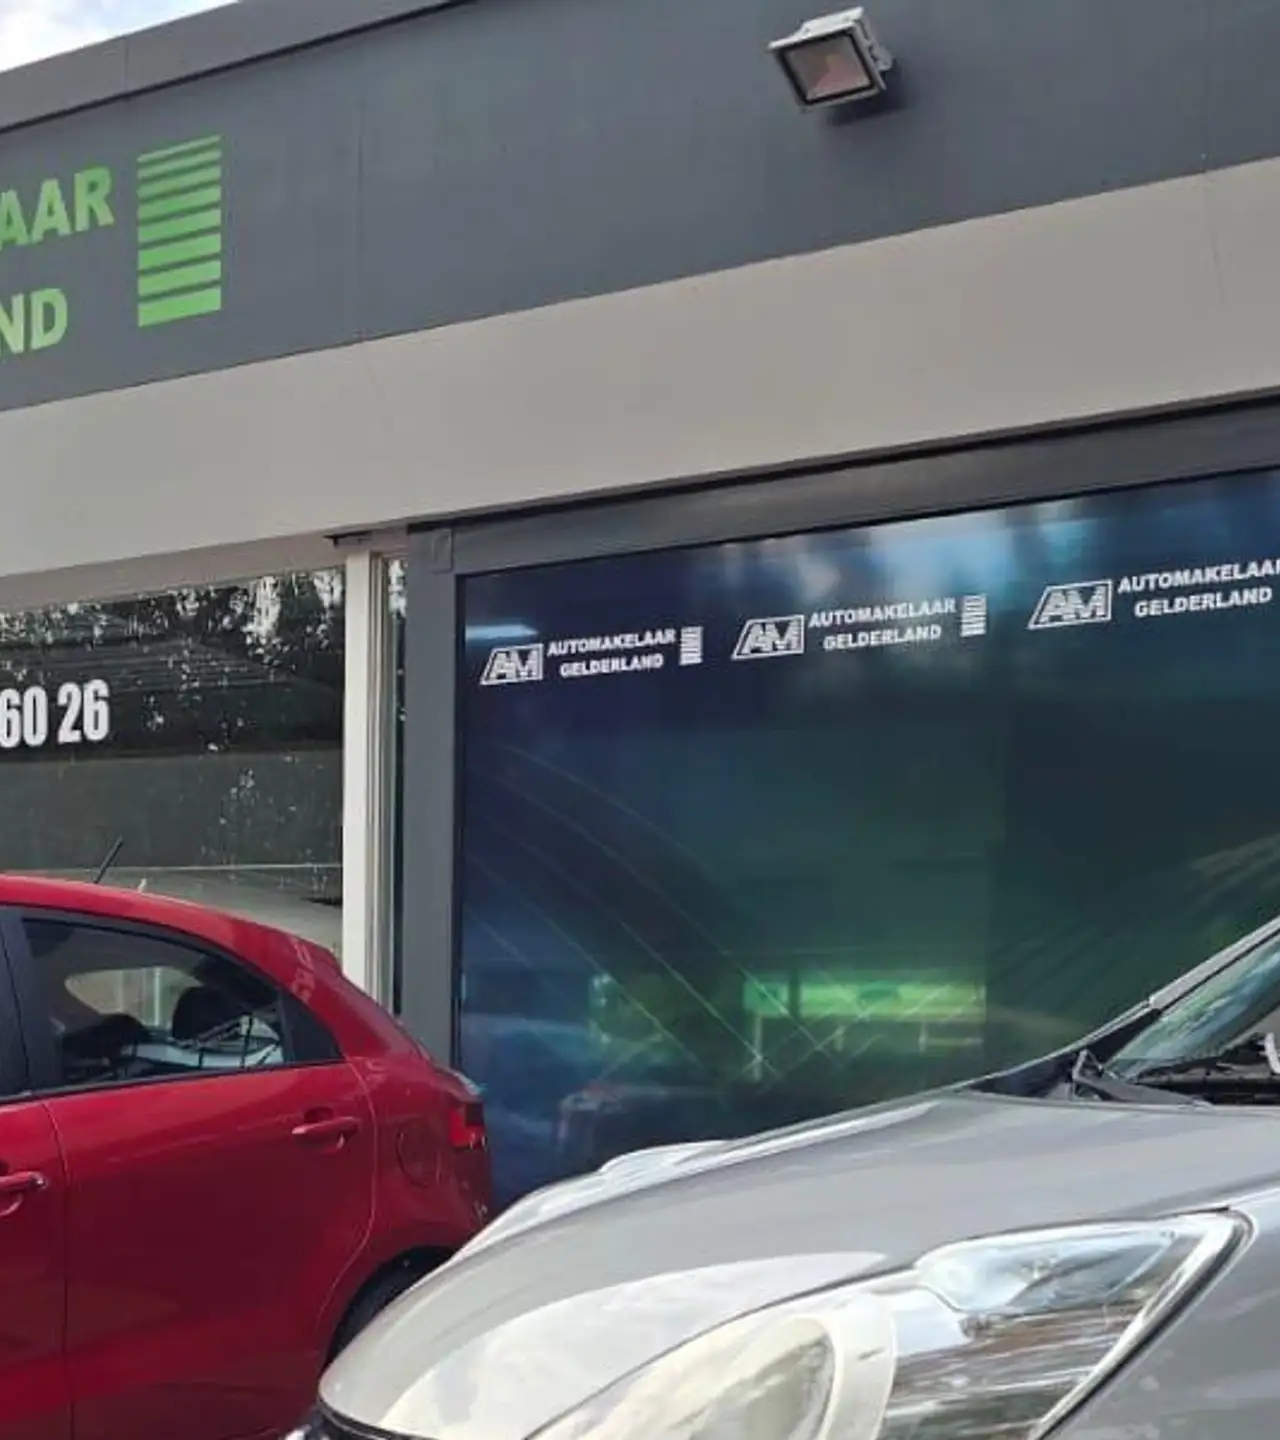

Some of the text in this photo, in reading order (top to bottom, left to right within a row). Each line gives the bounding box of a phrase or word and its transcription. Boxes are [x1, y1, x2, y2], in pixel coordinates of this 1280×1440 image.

[808, 596, 956, 629] AUTOMAKELAAR
[1133, 586, 1273, 619] GELDERLAND
[547, 629, 676, 657] AUTOMAKELAAR
[823, 624, 942, 650] GELDERLAND
[560, 653, 664, 678] GELDERLAND
[57, 679, 111, 743] 26
